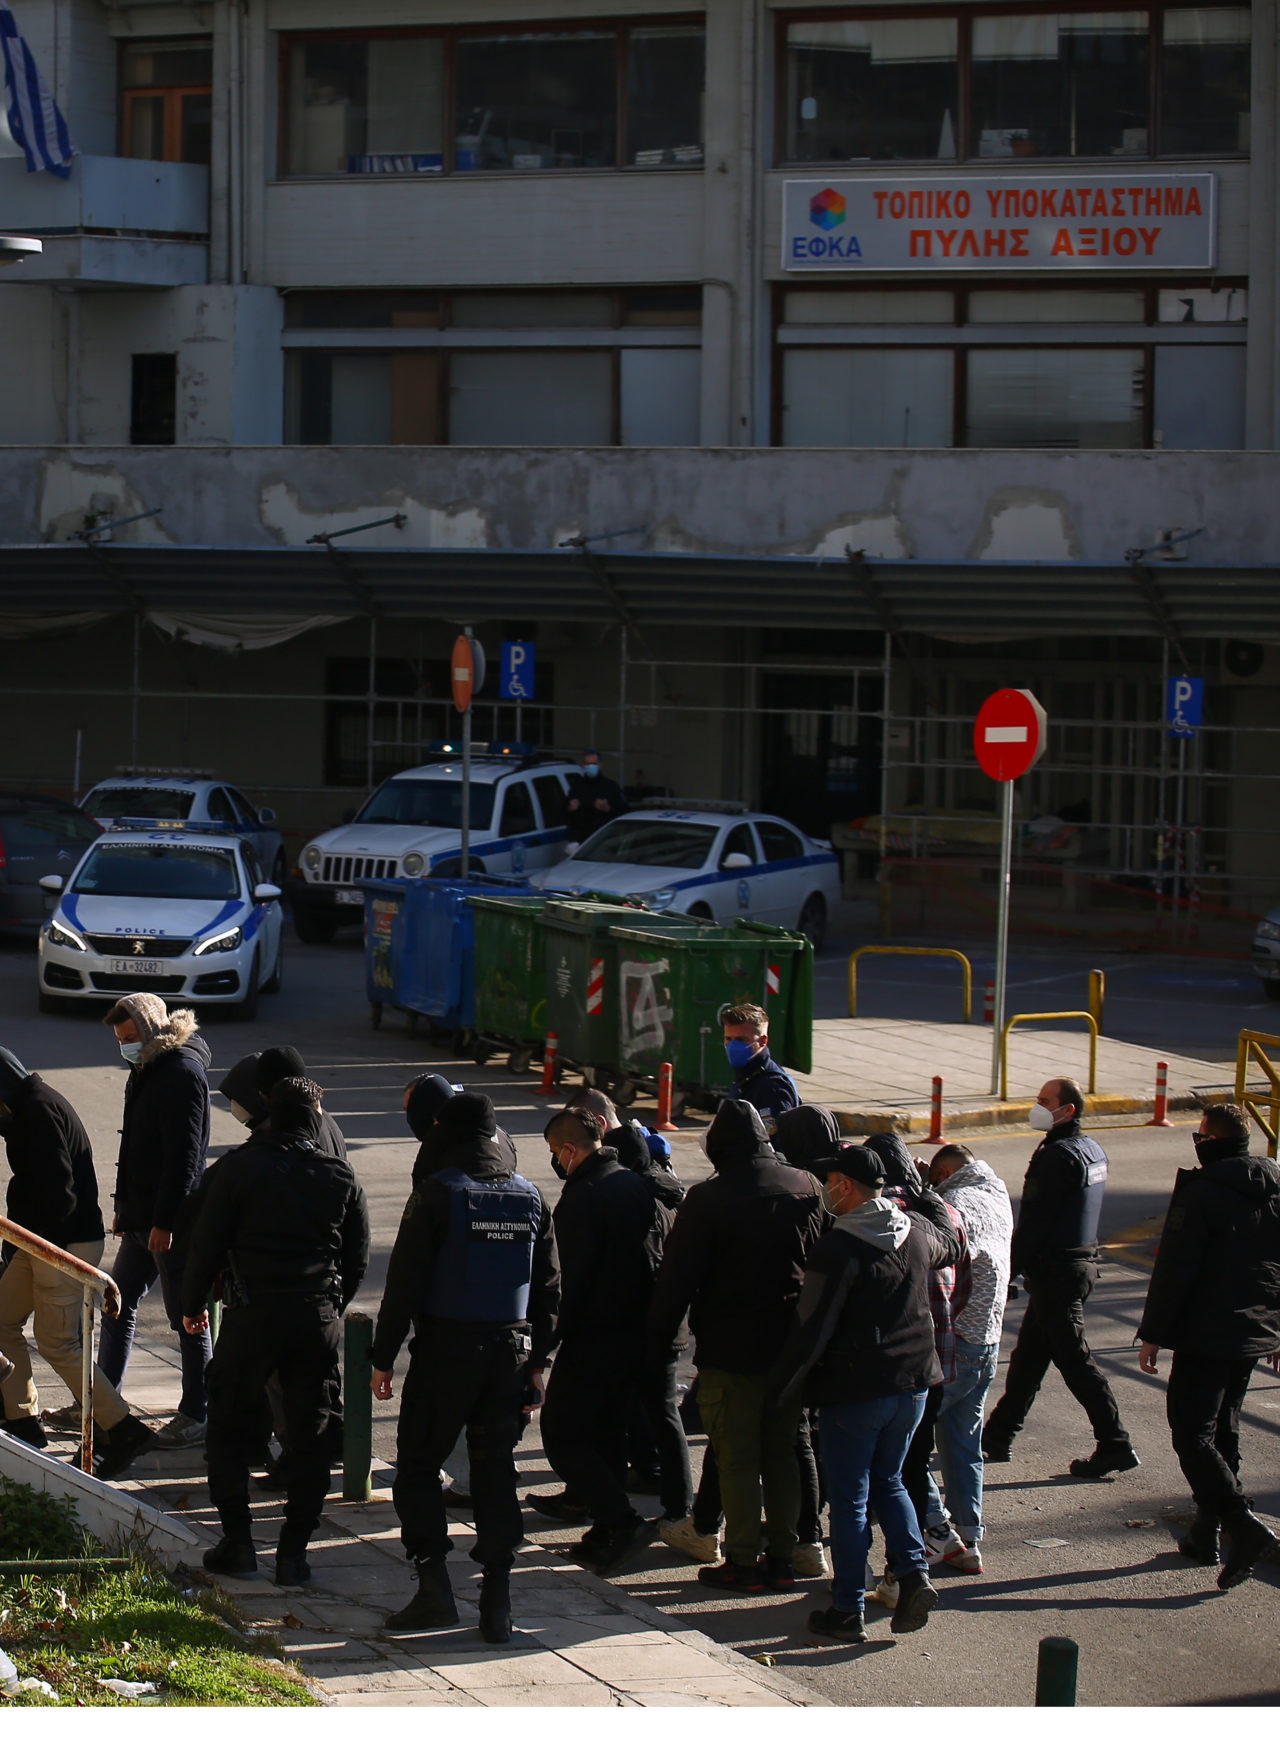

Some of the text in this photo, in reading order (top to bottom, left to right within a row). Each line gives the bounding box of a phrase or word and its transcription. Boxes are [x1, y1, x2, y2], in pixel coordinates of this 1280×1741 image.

[873, 187, 1202, 219] ΤΟΠΙΚΟ ΥΠΟΚΑΤΑΣΤΗΜΑ
[792, 236, 862, 258] ΕΦΚΑ
[909, 227, 1162, 258] ΠΥΛΗΣ ΑΞΙΟΥ
[510, 645, 526, 673] P
[1174, 680, 1192, 710] P
[115, 927, 166, 935] POLICE
[472, 1221, 531, 1231] ΕΛΛΗΝΙΚΗ ΑΣΤΥΝΟΜΙΑ
[487, 1232, 514, 1240] POLICE
